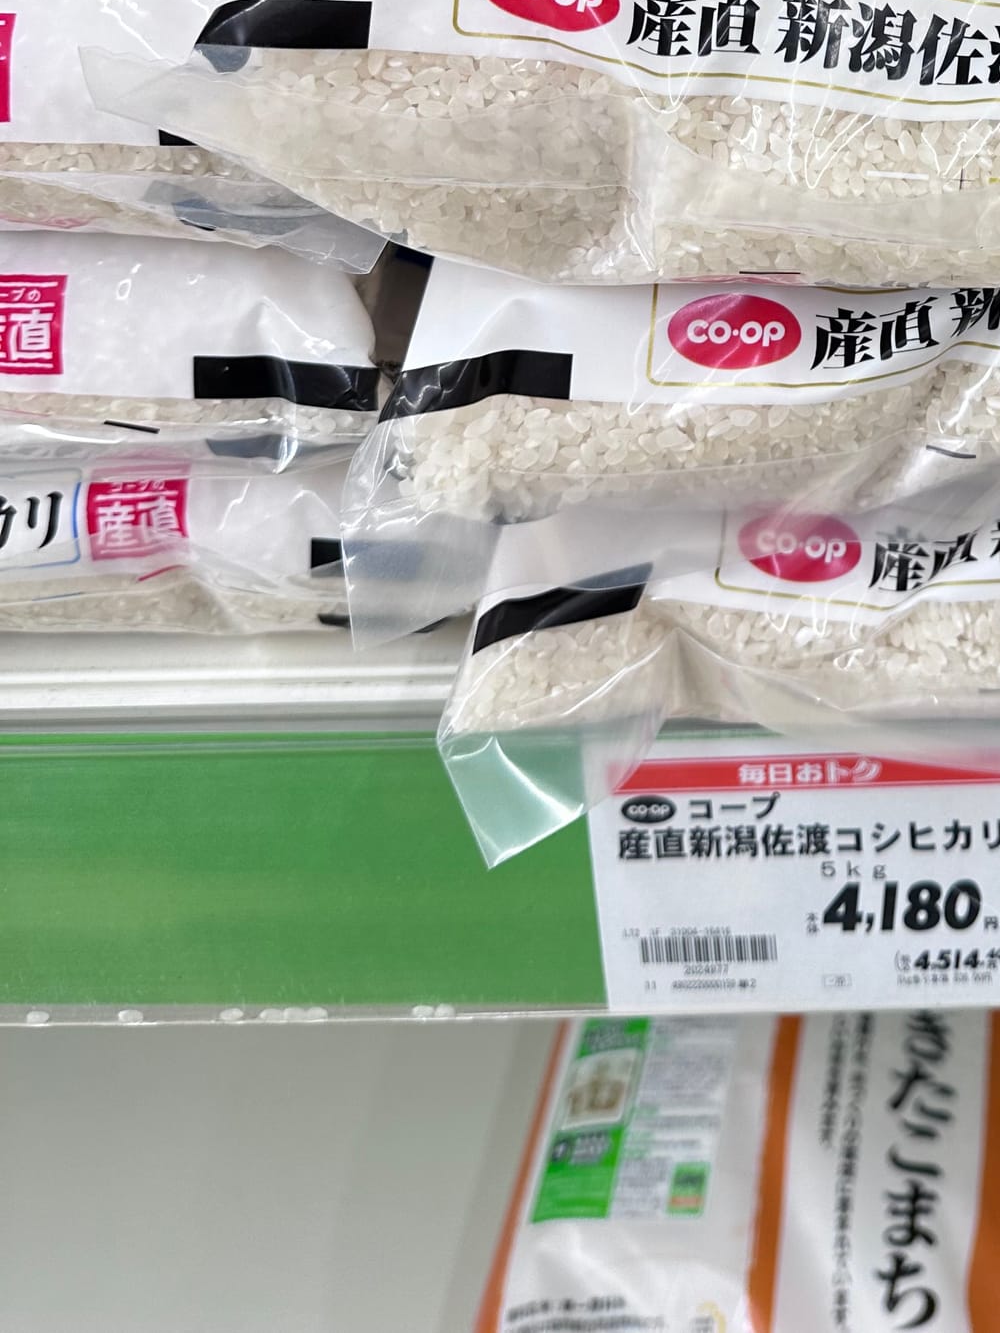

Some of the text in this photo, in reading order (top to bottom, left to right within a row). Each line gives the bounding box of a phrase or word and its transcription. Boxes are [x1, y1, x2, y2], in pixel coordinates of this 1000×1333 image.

[96, 497, 185, 549] 産直
[736, 761, 883, 785] 毎日おトク
[688, 791, 781, 820] コープ
[823, 878, 983, 933] 4,180
